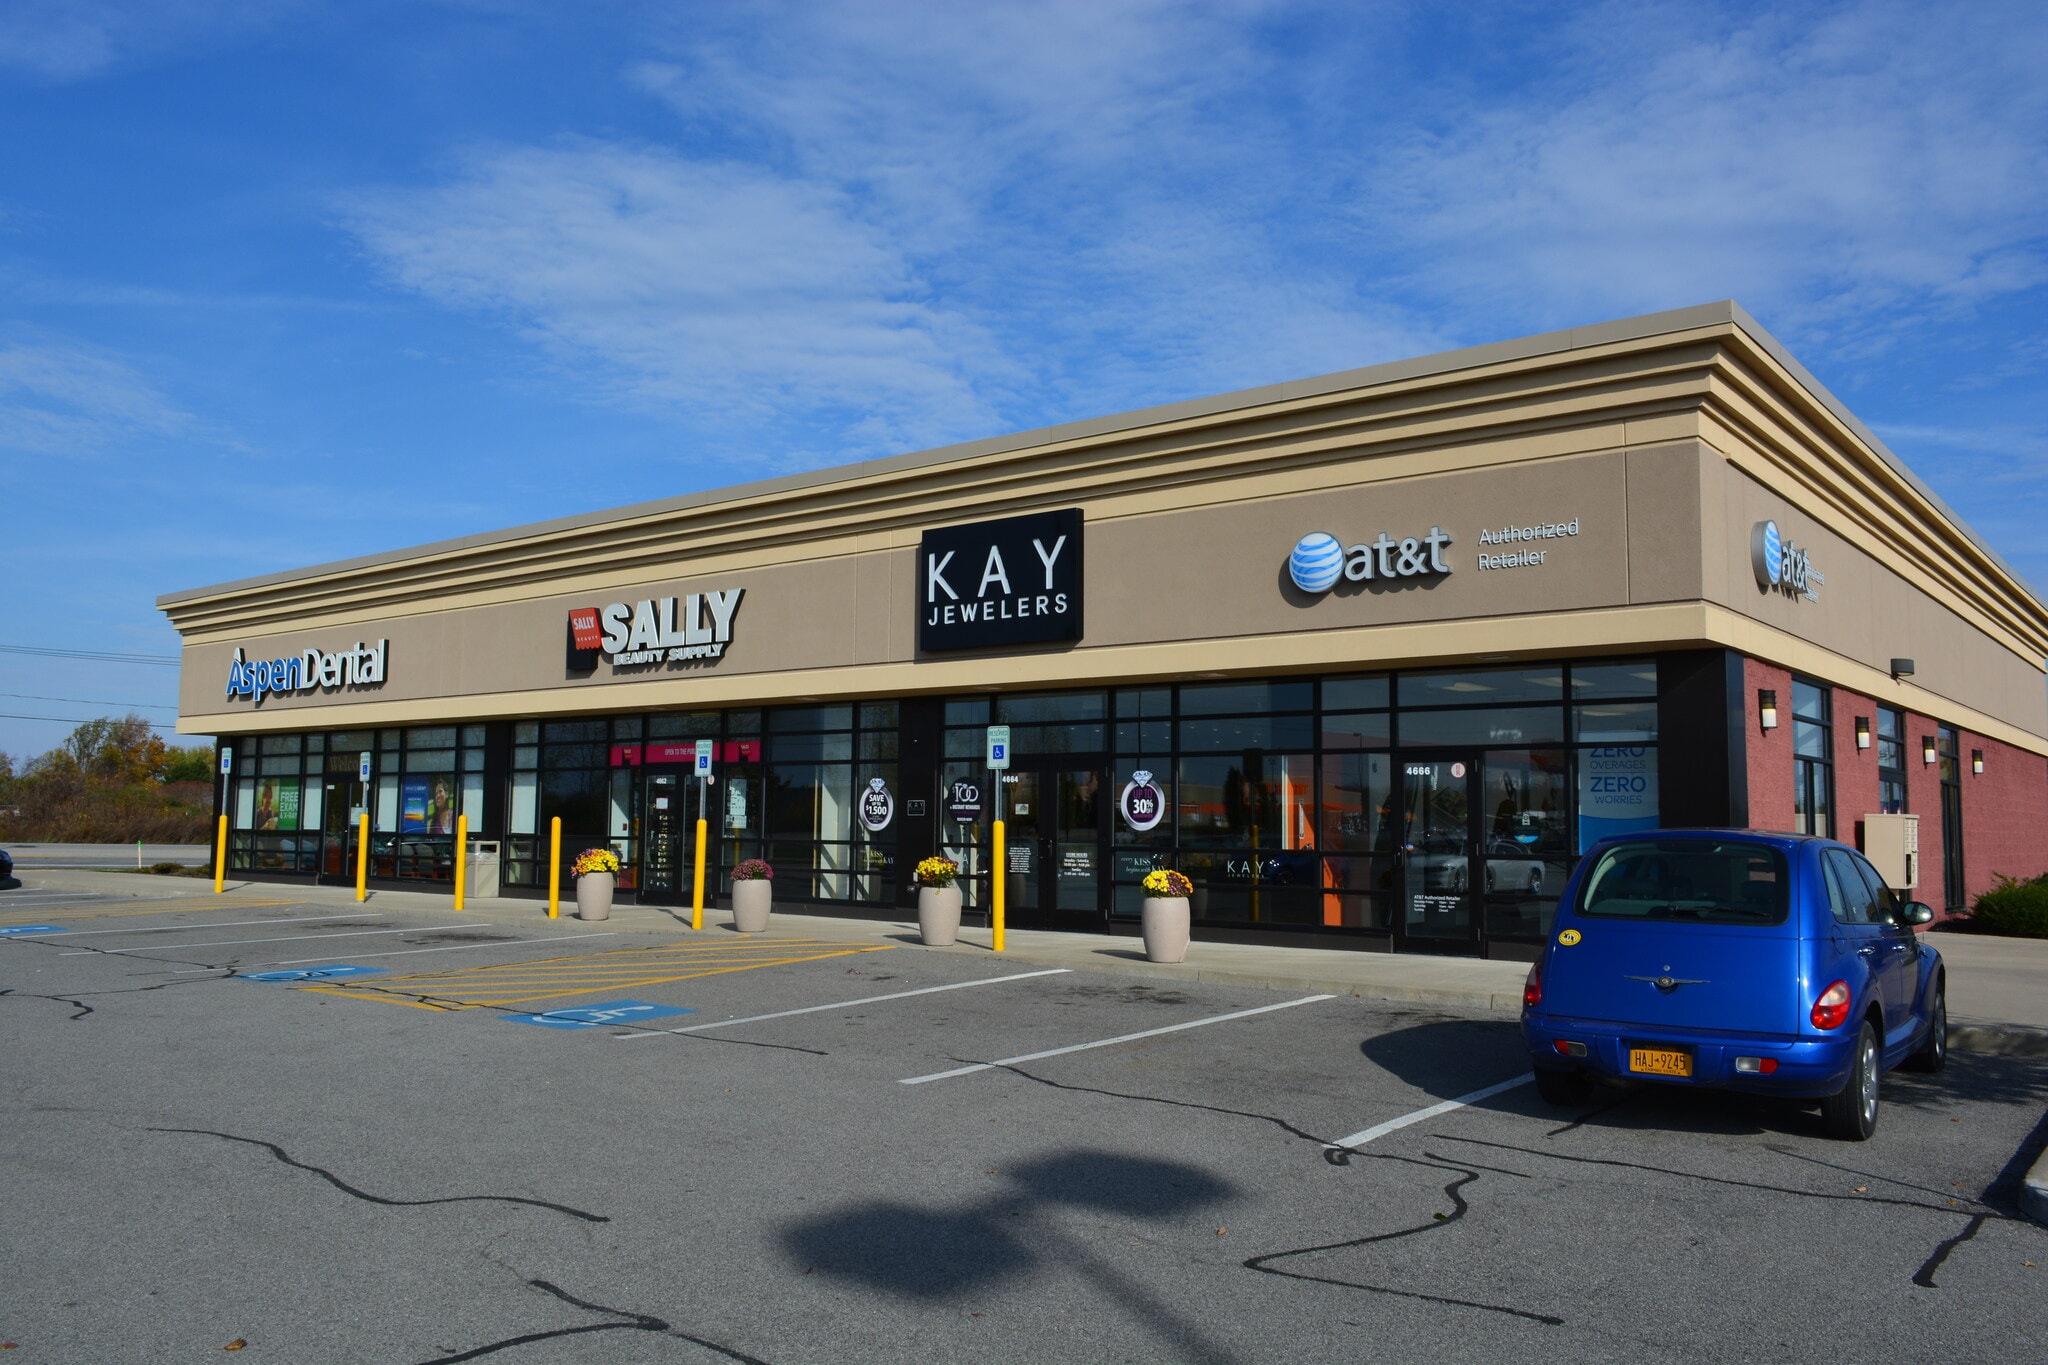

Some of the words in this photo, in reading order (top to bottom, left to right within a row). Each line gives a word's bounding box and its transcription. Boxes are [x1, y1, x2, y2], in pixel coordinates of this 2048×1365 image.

[1478, 518, 1579, 545] Authorized
[1345, 526, 1452, 581] at&t
[1478, 549, 1547, 570] Retailer
[928, 535, 1067, 602] KAY
[928, 593, 1067, 625] JEWELERS
[573, 616, 595, 631] SALLY
[601, 588, 741, 653] SALLY
[614, 650, 664, 666] BEAUTY
[668, 643, 723, 661] SUPPLY
[1406, 766, 1431, 776] 4666
[1590, 760, 1646, 770] OVERAGES
[1590, 776, 1646, 793] ZERO
[280, 791, 299, 802] FREE
[869, 794, 885, 802] SAVE
[1133, 789, 1143, 798] UP
[1144, 789, 1153, 798] TO
[1594, 795, 1642, 805] WORRIES
[280, 802, 298, 812] EXAM
[1132, 798, 1154, 814] 30%
[1134, 856, 1151, 866] KISS
[1227, 860, 1264, 874] KAY
